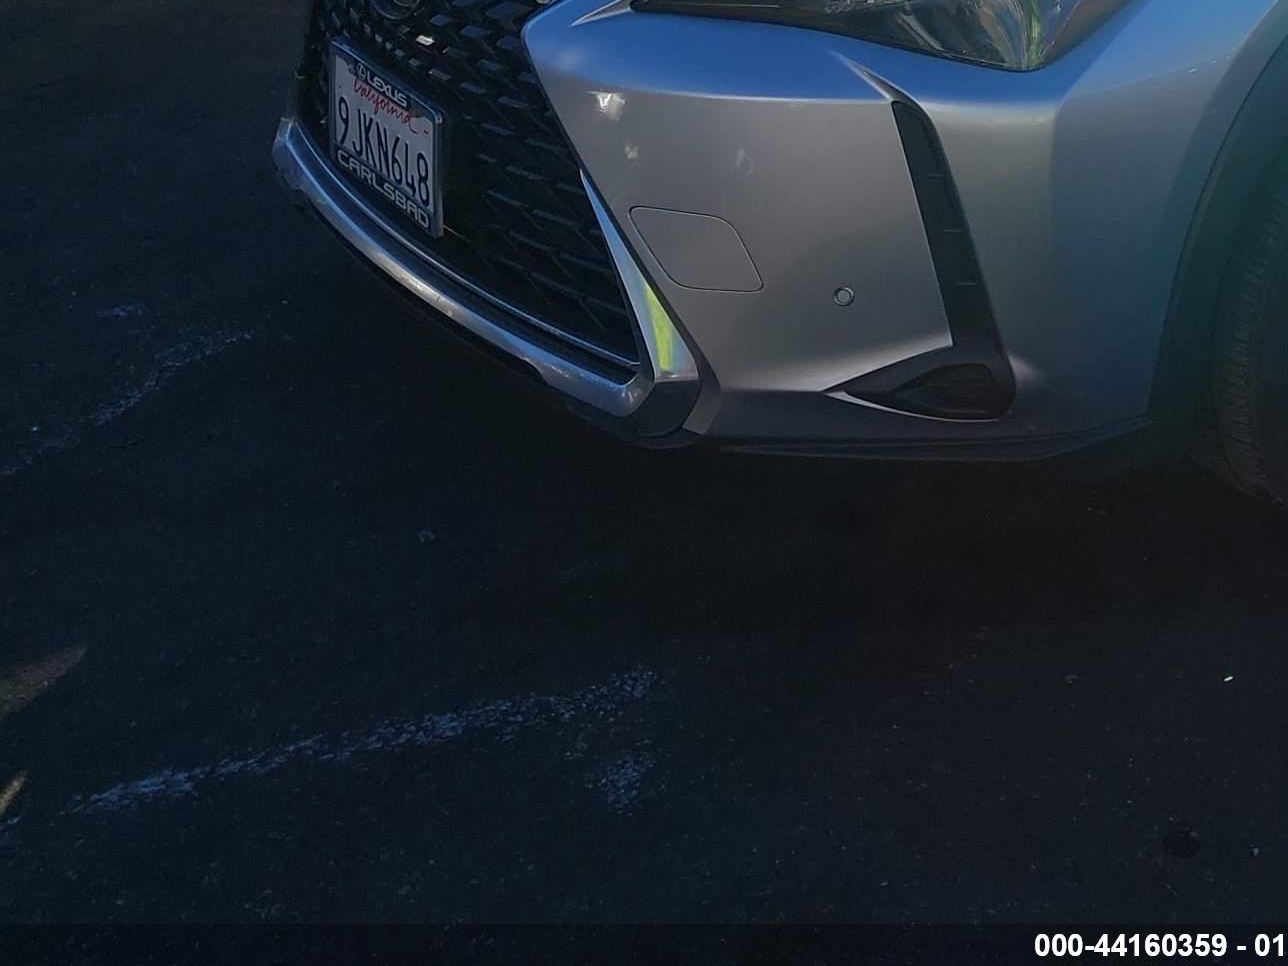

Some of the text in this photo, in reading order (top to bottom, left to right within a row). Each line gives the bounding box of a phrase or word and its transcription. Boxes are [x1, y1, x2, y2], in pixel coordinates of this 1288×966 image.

[366, 75, 408, 108] LEXUS
[337, 148, 430, 229] CARLSBAD
[338, 96, 430, 208] 9JKN648
